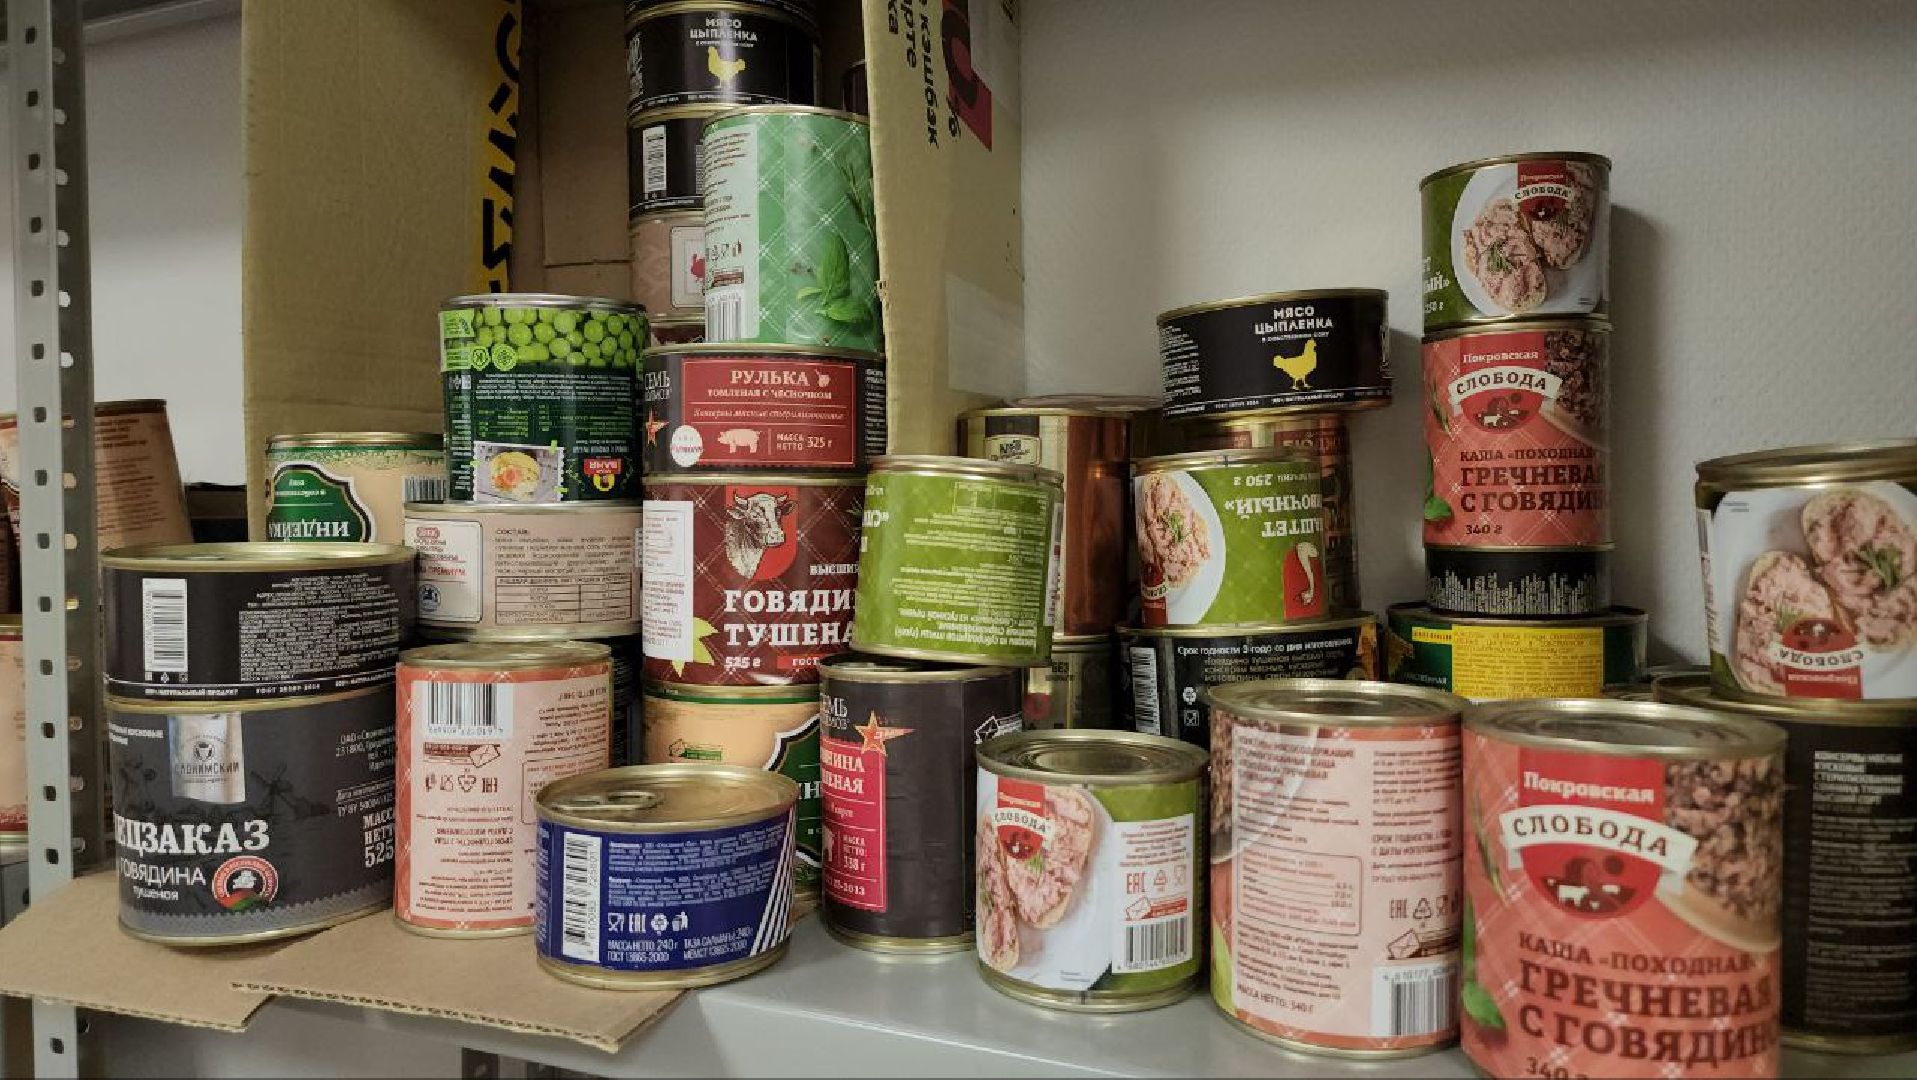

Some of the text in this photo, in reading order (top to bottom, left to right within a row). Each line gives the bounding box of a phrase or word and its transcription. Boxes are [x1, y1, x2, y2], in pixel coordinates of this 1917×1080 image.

[705, 18, 742, 28] МЯСО
[690, 28, 758, 42] ЦЫПЛЕНКА
[920, 13, 940, 150] кэшбэк
[1514, 185, 1572, 200] СЛОБОДА
[1273, 305, 1315, 320] МЯСО
[1254, 317, 1334, 335] ЦЫПЛЕНКА
[1462, 349, 1540, 364] Покровская
[731, 369, 810, 386] РУЛЬКА
[1456, 371, 1547, 395] СЛОБОДА
[707, 388, 761, 398] ТОМЛЕНАЯ
[770, 389, 832, 400] ЧЕСНОЧКОМ
[776, 432, 804, 442] МАССА
[807, 435, 826, 448] 325
[776, 441, 804, 451] НЕТТО
[1460, 449, 1504, 462] КАША
[1246, 473, 1273, 487] 250
[1460, 493, 1477, 513] С
[1465, 524, 1491, 535] 340
[723, 589, 858, 616] ГОВЯДИ
[1177, 645, 1199, 657] Срок
[1200, 645, 1241, 656] годности
[1249, 645, 1272, 655] года
[1778, 648, 1865, 667] СЛОБОДА
[723, 656, 750, 669] 525
[1522, 770, 1656, 805] Покровская
[994, 811, 1046, 834] СЛОБОДА
[1512, 813, 1669, 857] СЛОБОДА
[364, 840, 394, 869] 525
[120, 856, 208, 888] ГОВЯДИНА
[1518, 931, 1594, 965] КАША
[607, 950, 625, 962] ГОСТ
[1519, 1004, 1545, 1039] С
